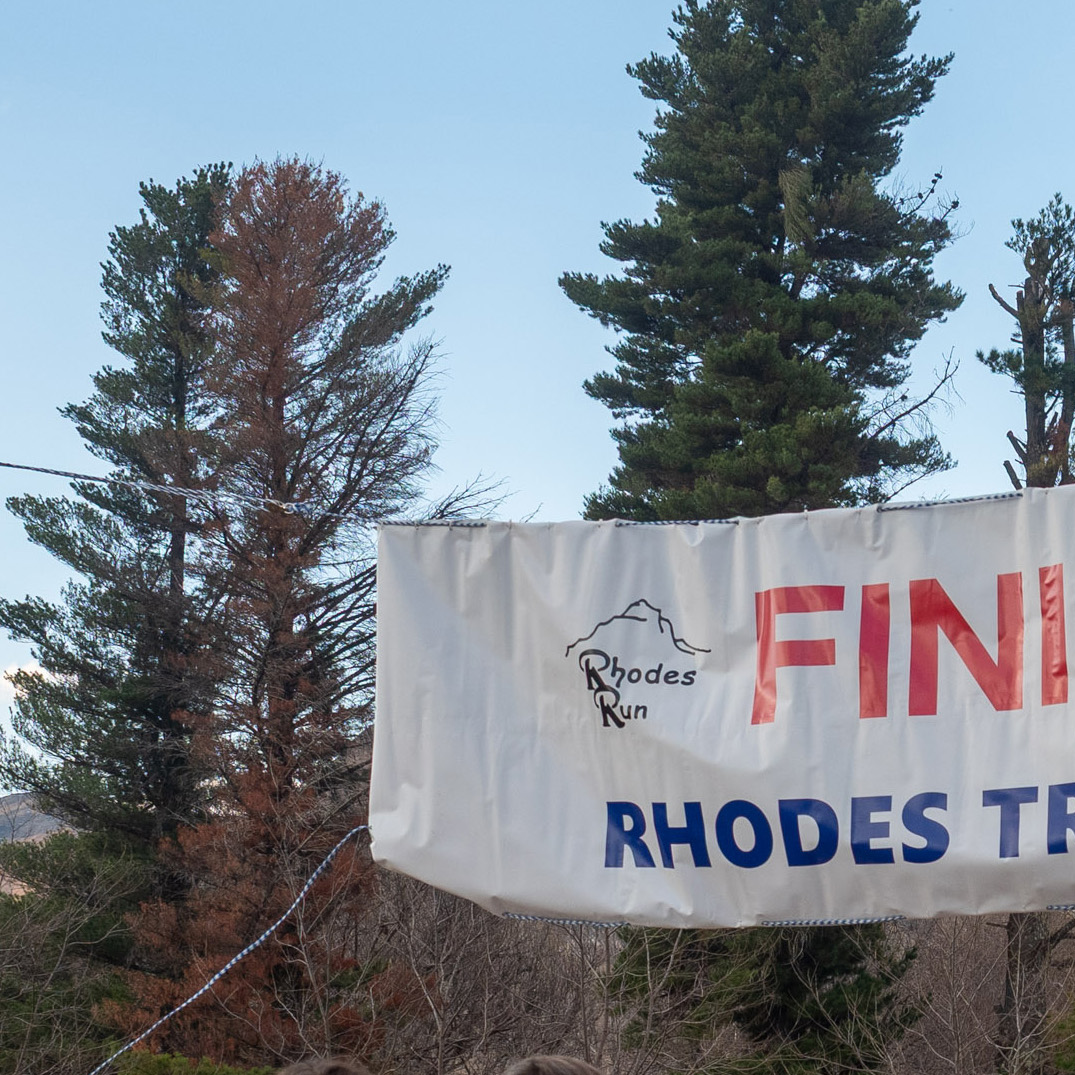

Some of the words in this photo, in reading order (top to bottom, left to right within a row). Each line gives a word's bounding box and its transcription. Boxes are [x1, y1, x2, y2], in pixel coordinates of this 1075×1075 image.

[579, 649, 697, 691] Rhodes
[594, 684, 648, 729] Run
[605, 791, 950, 869] RHODES
